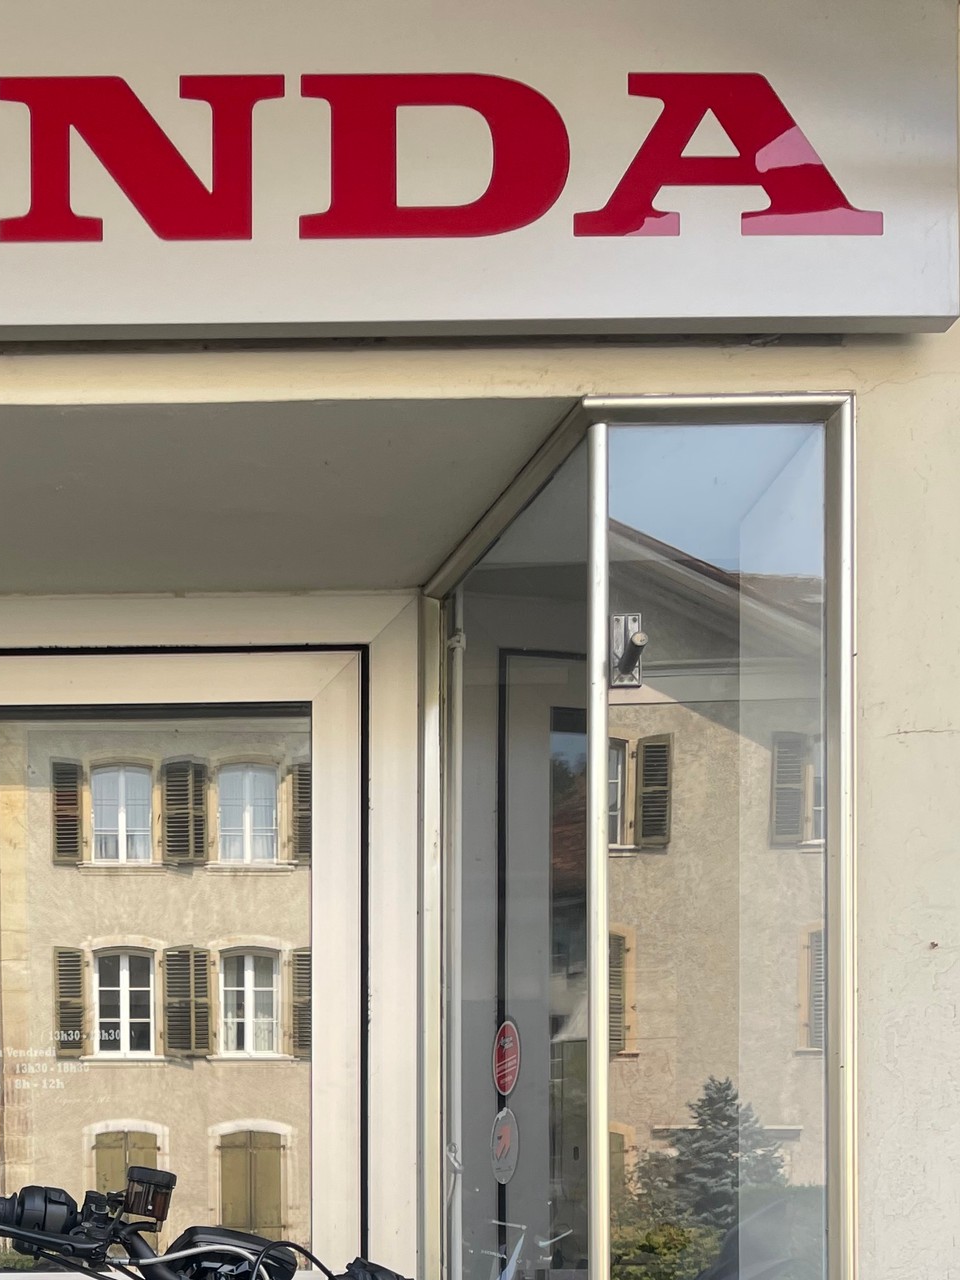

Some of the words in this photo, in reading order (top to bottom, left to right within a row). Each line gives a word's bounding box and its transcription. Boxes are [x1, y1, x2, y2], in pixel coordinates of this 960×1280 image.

[6, 1046, 56, 1057] Vendredi
[15, 1063, 48, 1074] 13h30
[57, 1062, 90, 1073] 18h30
[14, 1079, 31, 1090] 8h
[41, 1078, 65, 1089] 12h
